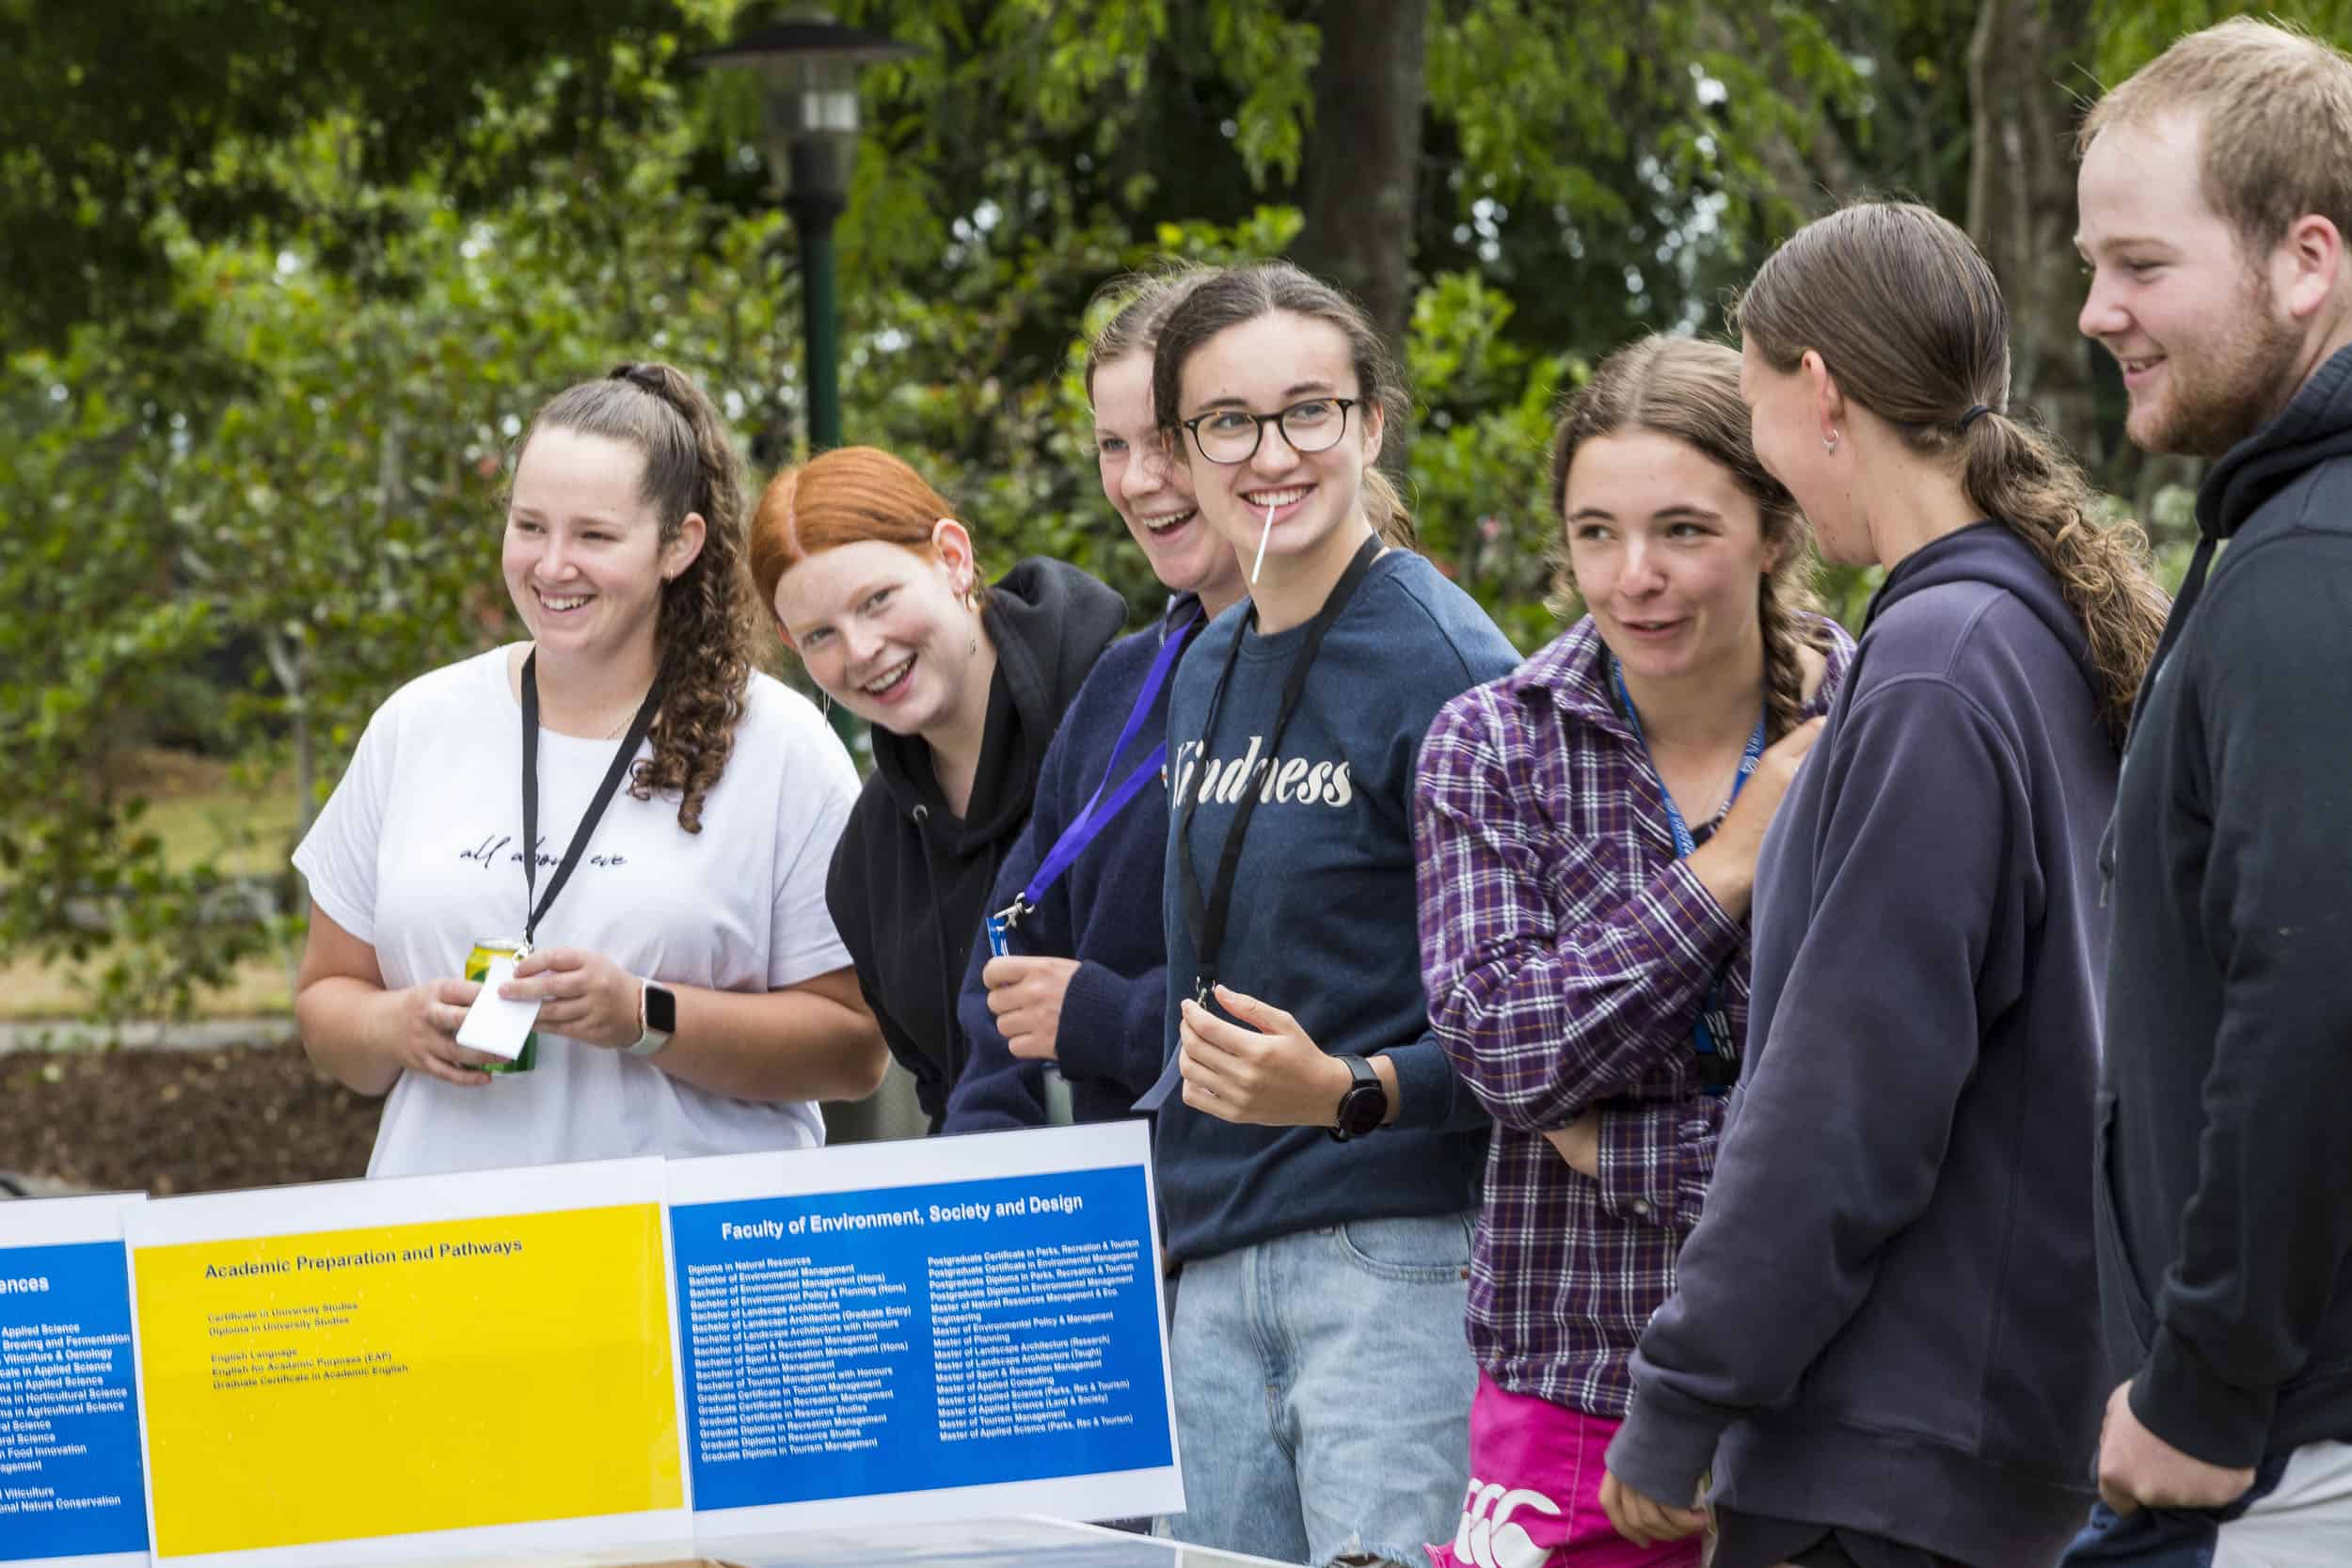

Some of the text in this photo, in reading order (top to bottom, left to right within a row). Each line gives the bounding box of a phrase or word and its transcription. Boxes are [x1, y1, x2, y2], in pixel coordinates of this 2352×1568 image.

[459, 834, 511, 870] all
[721, 1193, 1083, 1243] Faculty of Environment, Society and Design
[204, 1238, 523, 1279] Academic Preparation and Pathways
[1, 1323, 80, 1338] Applied Science
[3, 1335, 130, 1352] Brewing and Fermentation
[3, 1349, 113, 1363] Viticulture & Oenology
[22, 1367, 32, 1375] in
[33, 1364, 72, 1377] Applied
[72, 1362, 112, 1373] Science
[13, 1380, 23, 1389] in
[24, 1378, 62, 1391] Applied
[64, 1376, 103, 1386] Science
[13, 1393, 24, 1402] in
[25, 1390, 87, 1402] Horticultural
[88, 1388, 127, 1399] Science
[14, 1406, 24, 1417] in
[25, 1403, 84, 1418] Agricultural
[85, 1402, 124, 1413] Science
[11, 1419, 51, 1431] Science
[16, 1433, 56, 1444] Science
[7, 1447, 33, 1458] Food
[34, 1444, 87, 1456] Innovation
[4, 1486, 55, 1498] Viticulture
[21, 1499, 54, 1511] Nature
[55, 1496, 120, 1509] Conservation
